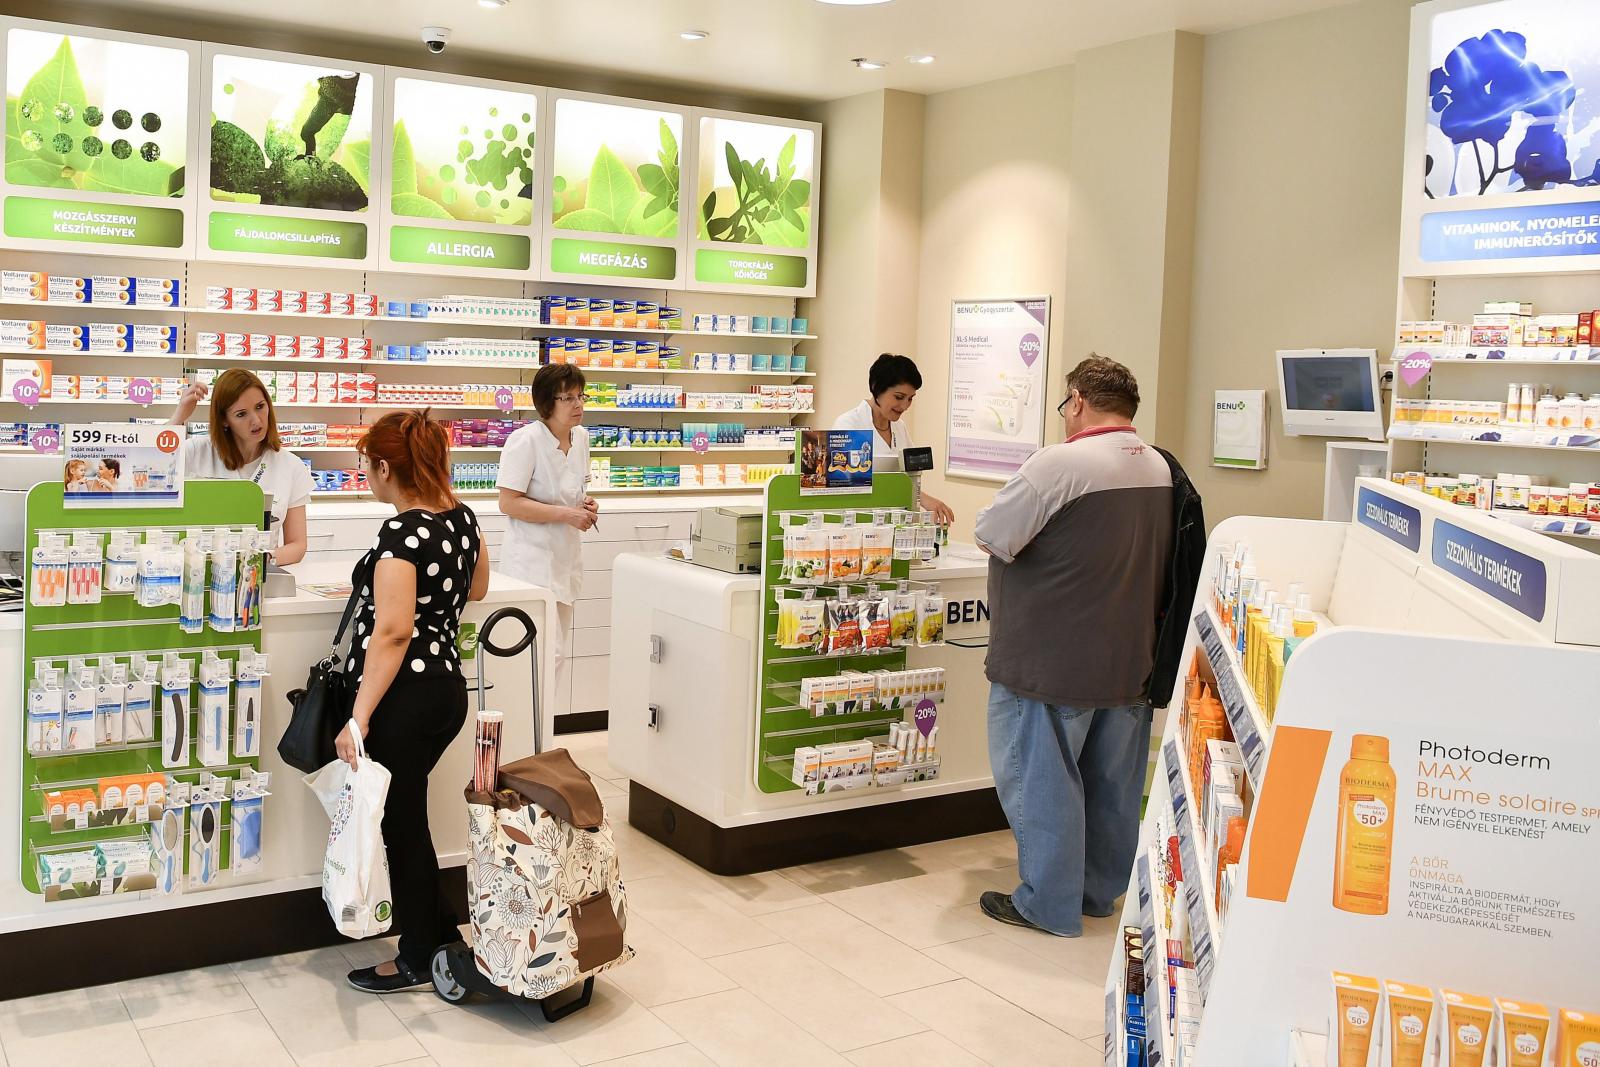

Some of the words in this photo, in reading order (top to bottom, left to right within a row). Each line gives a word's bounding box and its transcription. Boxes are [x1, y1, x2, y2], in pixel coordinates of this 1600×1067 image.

[53, 209, 136, 226] MOZGÁSSZERVI
[53, 222, 136, 238] KÉSZÍTMÉNYEK
[234, 227, 341, 246] FÁJDALOMCSILLAPÍTÁS
[1442, 220, 1524, 237] VITAMINOK,
[1474, 230, 1598, 250] IMMUNERŐSÍTŐK
[426, 242, 495, 259] ALLERGIA
[579, 251, 648, 269] MEGFÁZÁS
[734, 268, 768, 280] KÖHÖGÉS
[1020, 341, 1040, 351] -20%
[1401, 359, 1431, 369] -20%
[14, 385, 39, 398] -10%
[129, 385, 152, 397] -10%
[1216, 402, 1237, 410] BENU
[33, 435, 57, 447] -10%
[72, 430, 101, 443] 599
[105, 433, 139, 444] Ft-tól
[159, 433, 176, 448] ÚJ
[71, 446, 85, 454] Saját
[253, 470, 265, 483] BENU
[1366, 503, 1388, 528] SZEZONÁLIS
[1388, 511, 1410, 537] TERMÉKEK
[1446, 539, 1484, 577] SZEZONÁLIS
[1484, 560, 1522, 596] TERMÉKEK
[947, 600, 990, 624] BEN
[915, 708, 937, 721] -20%
[1419, 740, 1551, 771] Photoderm
[1417, 760, 1473, 782] MAX
[1345, 777, 1390, 790] BIODERMA
[1416, 781, 1491, 805] Brume
[1498, 794, 1577, 816] solaire
[1361, 814, 1384, 825] 50+
[1414, 815, 1440, 827] NEM
[1442, 818, 1490, 834] IGÉNYEL
[1492, 825, 1545, 839] ELKENÉST
[1415, 804, 1476, 820] FÉNYVÉDŐ
[1479, 812, 1548, 830] TESTPERMET,
[1551, 821, 1591, 835] AMELY
[1410, 856, 1420, 866] A
[1422, 856, 1449, 869] BŐR
[1409, 867, 1464, 885] ÖNMAGA
[1409, 880, 1464, 895] INSPIRÁLTA
[1475, 888, 1531, 904] BIODERMÁT,
[1534, 898, 1561, 908] HOGY
[1408, 890, 1460, 905] AKTIVÁLJA
[1461, 894, 1503, 910] BŐRÜNK
[1505, 903, 1576, 921] TERMÉSZETES
[1408, 901, 1520, 923] VÉDEKEZŐKÉPESSÉGÉT
[1416, 913, 1502, 931] NAPSUGARAKKAL
[1504, 924, 1554, 938] SZEMBEN.
